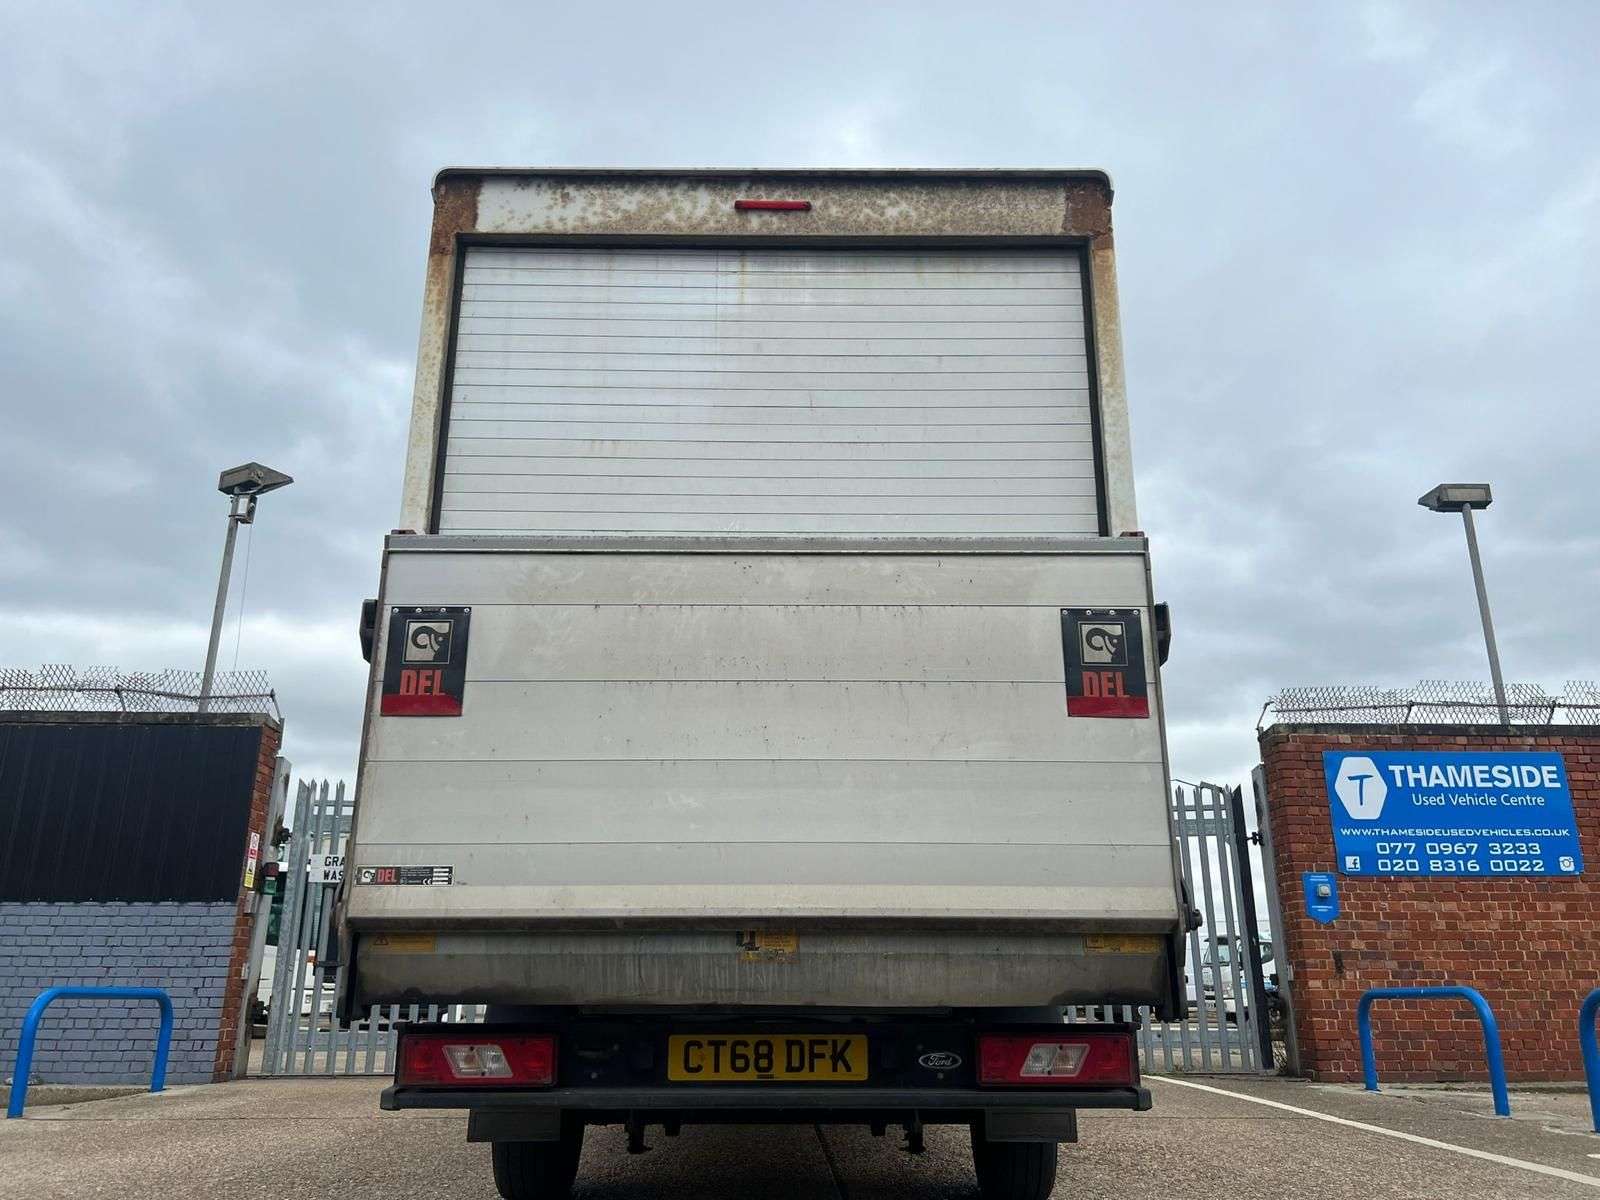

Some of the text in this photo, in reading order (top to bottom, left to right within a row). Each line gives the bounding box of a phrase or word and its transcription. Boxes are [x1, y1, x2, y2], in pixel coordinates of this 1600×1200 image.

[400, 669, 446, 696] DEL
[1081, 671, 1131, 698] DEL
[1388, 765, 1561, 789] THAMESIDE
[1412, 793, 1545, 806] Used Vehicle Centre
[1340, 828, 1570, 837] WWW.THAMESIDEUSEDVEHICLES.CO.UK
[1376, 843, 1541, 855] 077 0967 3233
[1378, 859, 1545, 872] 020 8316 0022
[377, 868, 397, 882] DEL
[683, 1039, 852, 1073] CT68 DFK
[928, 1055, 952, 1066] Ford
